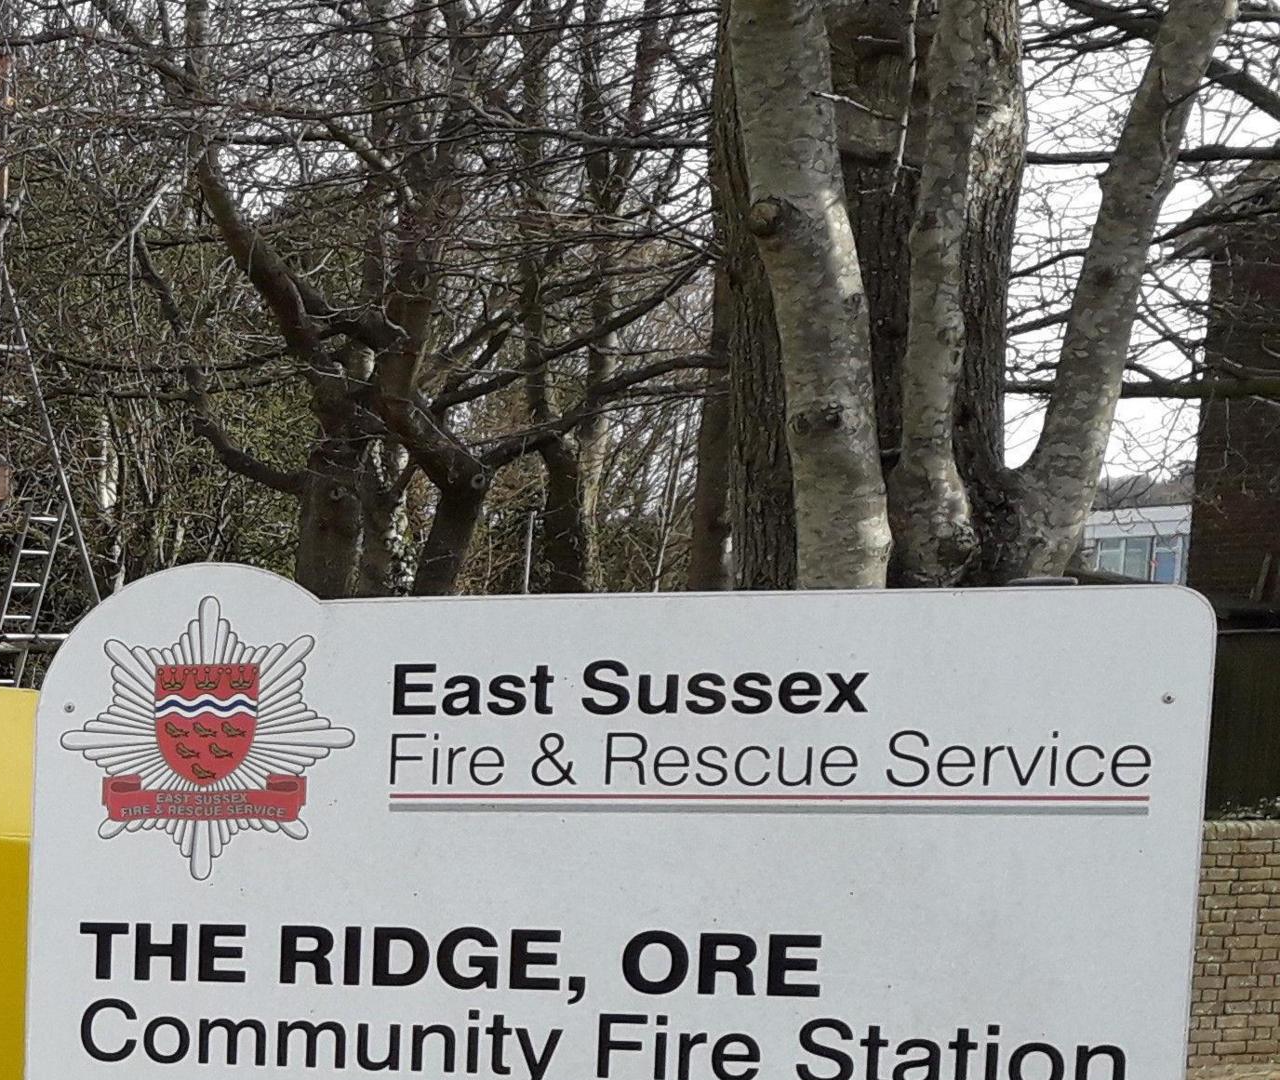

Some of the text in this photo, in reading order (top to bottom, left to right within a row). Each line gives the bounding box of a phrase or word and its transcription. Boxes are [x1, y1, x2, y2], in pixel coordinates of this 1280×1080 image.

[392, 659, 870, 717] East Sussex
[389, 729, 1152, 788] Fire & Rescue Service
[120, 805, 287, 818] FIRE & RESCUE SERVICE
[156, 793, 248, 805] EAST SUSSEX
[79, 921, 822, 1005] THE RIDGE, ORE
